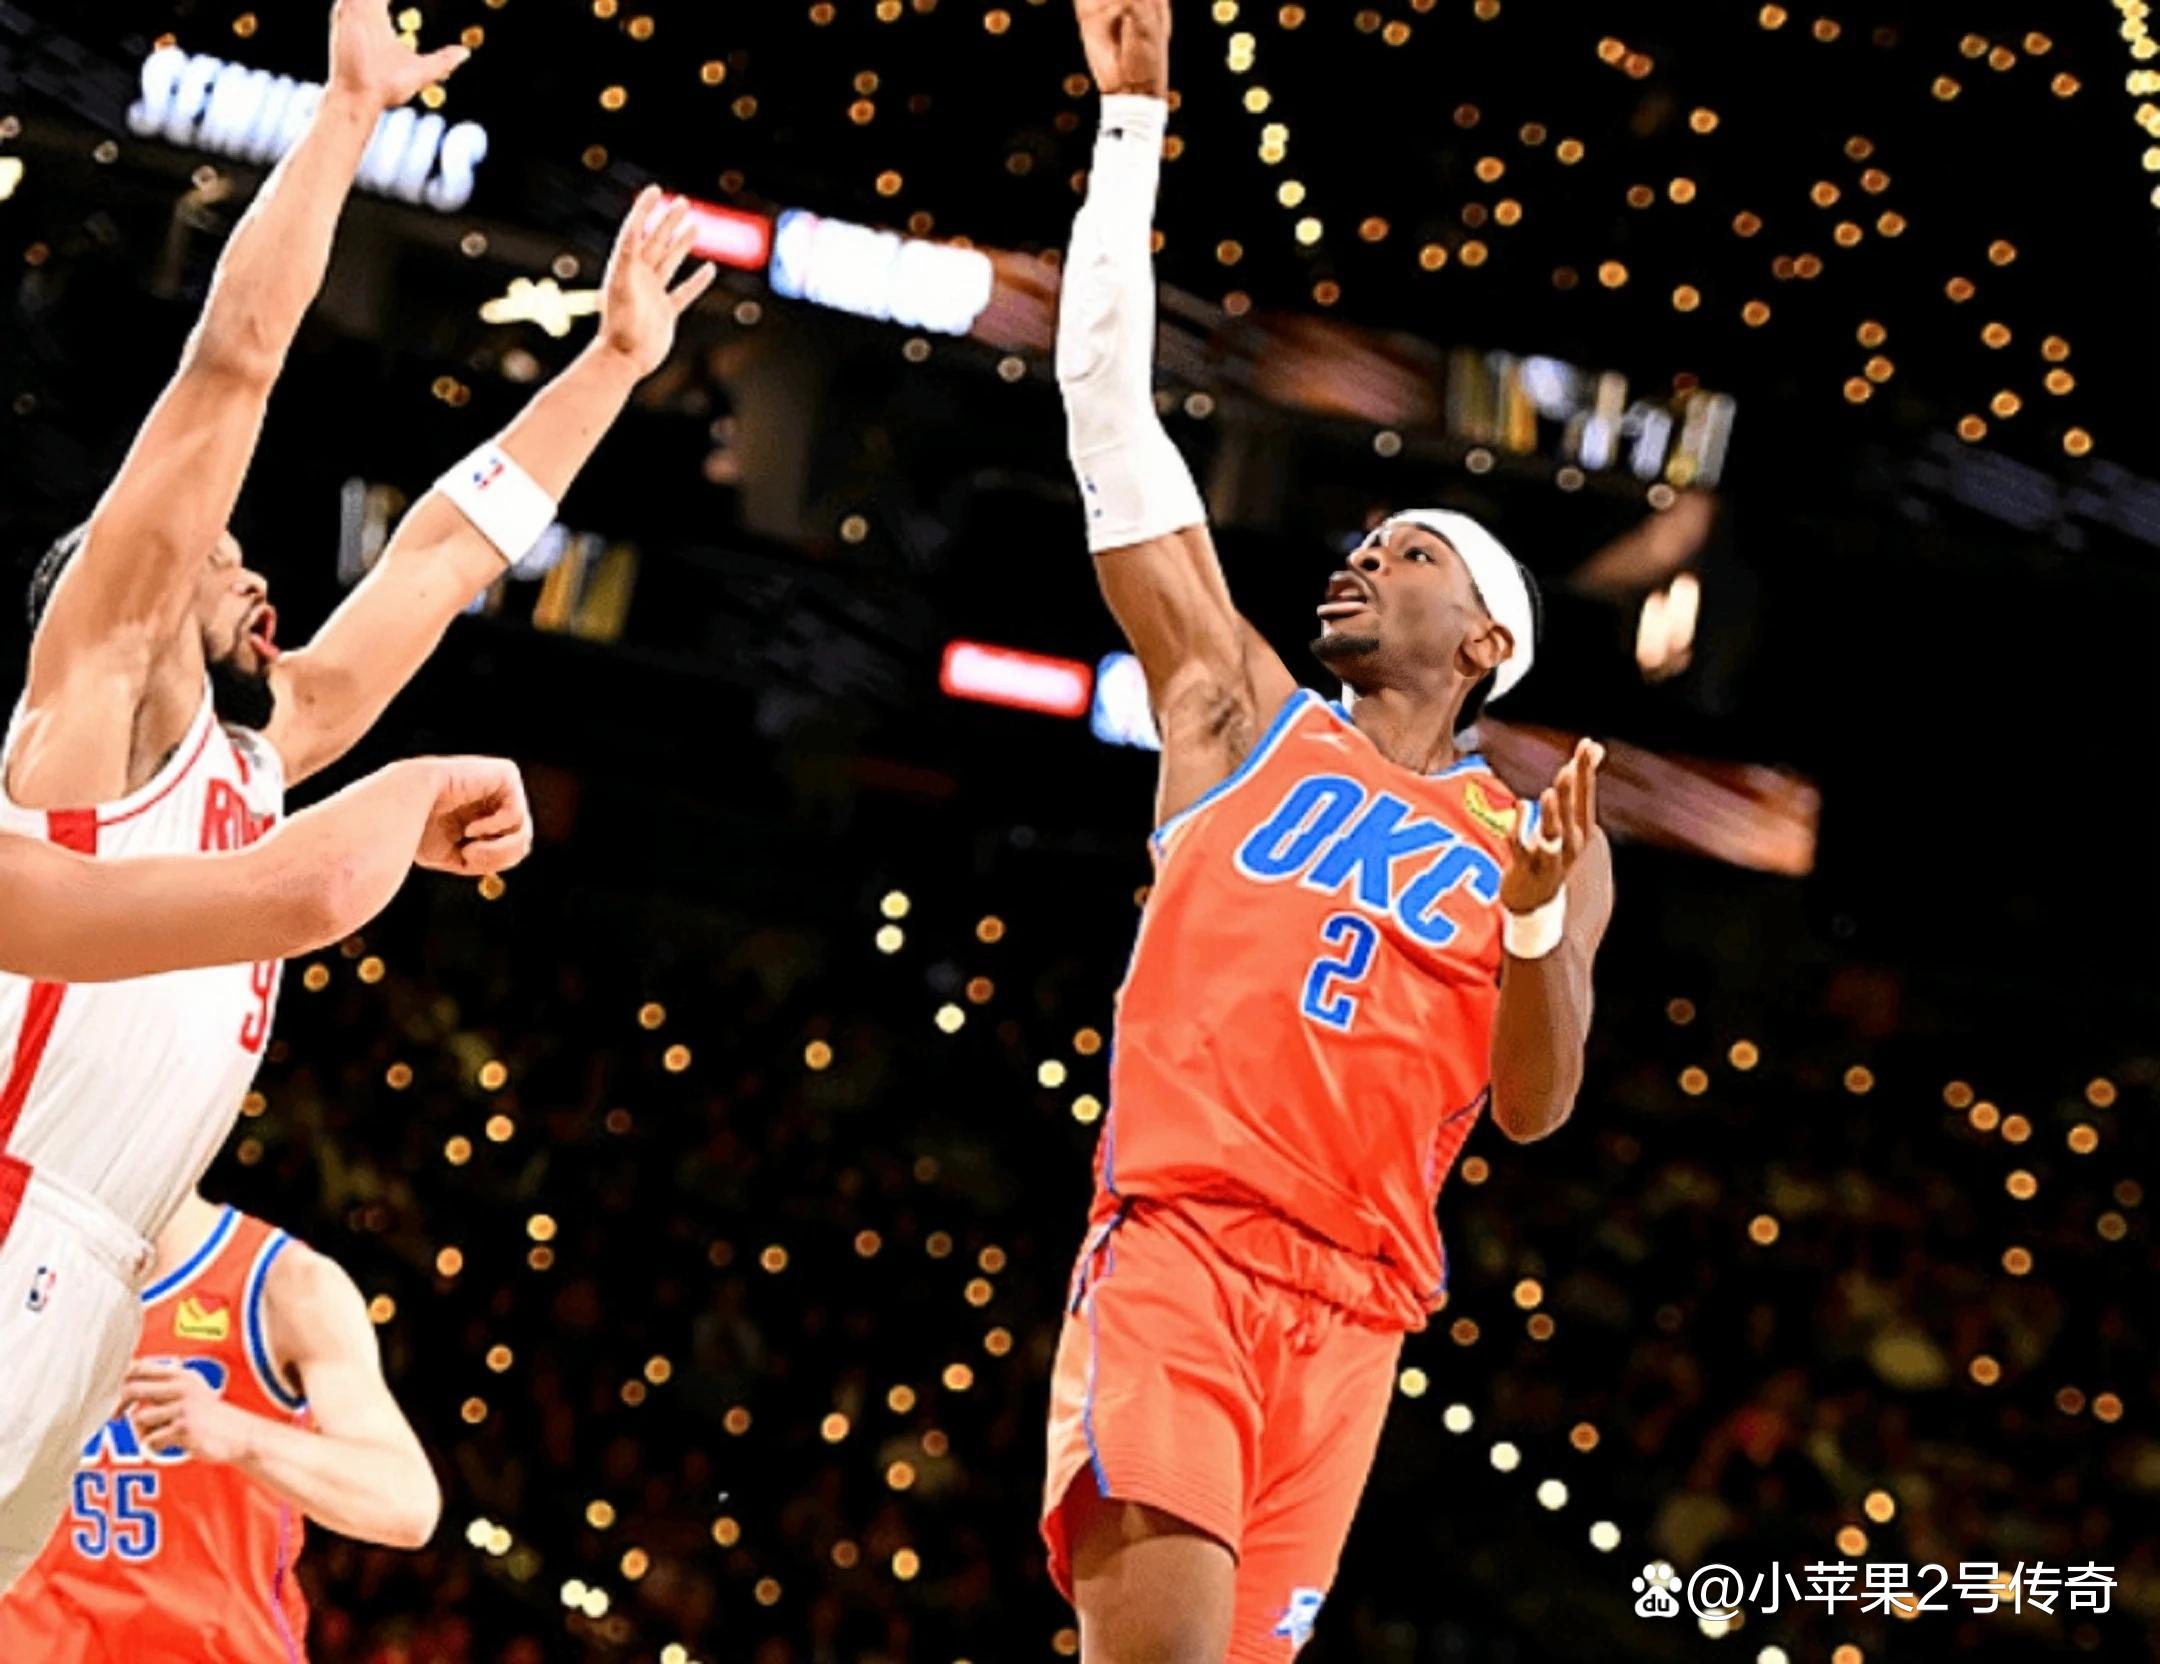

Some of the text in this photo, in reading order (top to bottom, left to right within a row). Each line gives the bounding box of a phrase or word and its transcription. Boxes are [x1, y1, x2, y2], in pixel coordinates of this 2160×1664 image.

[1235, 774, 1501, 947] OKC
[239, 957, 277, 1054] 9
[1302, 911, 1378, 1030] 2
[73, 1470, 160, 1560] 55
